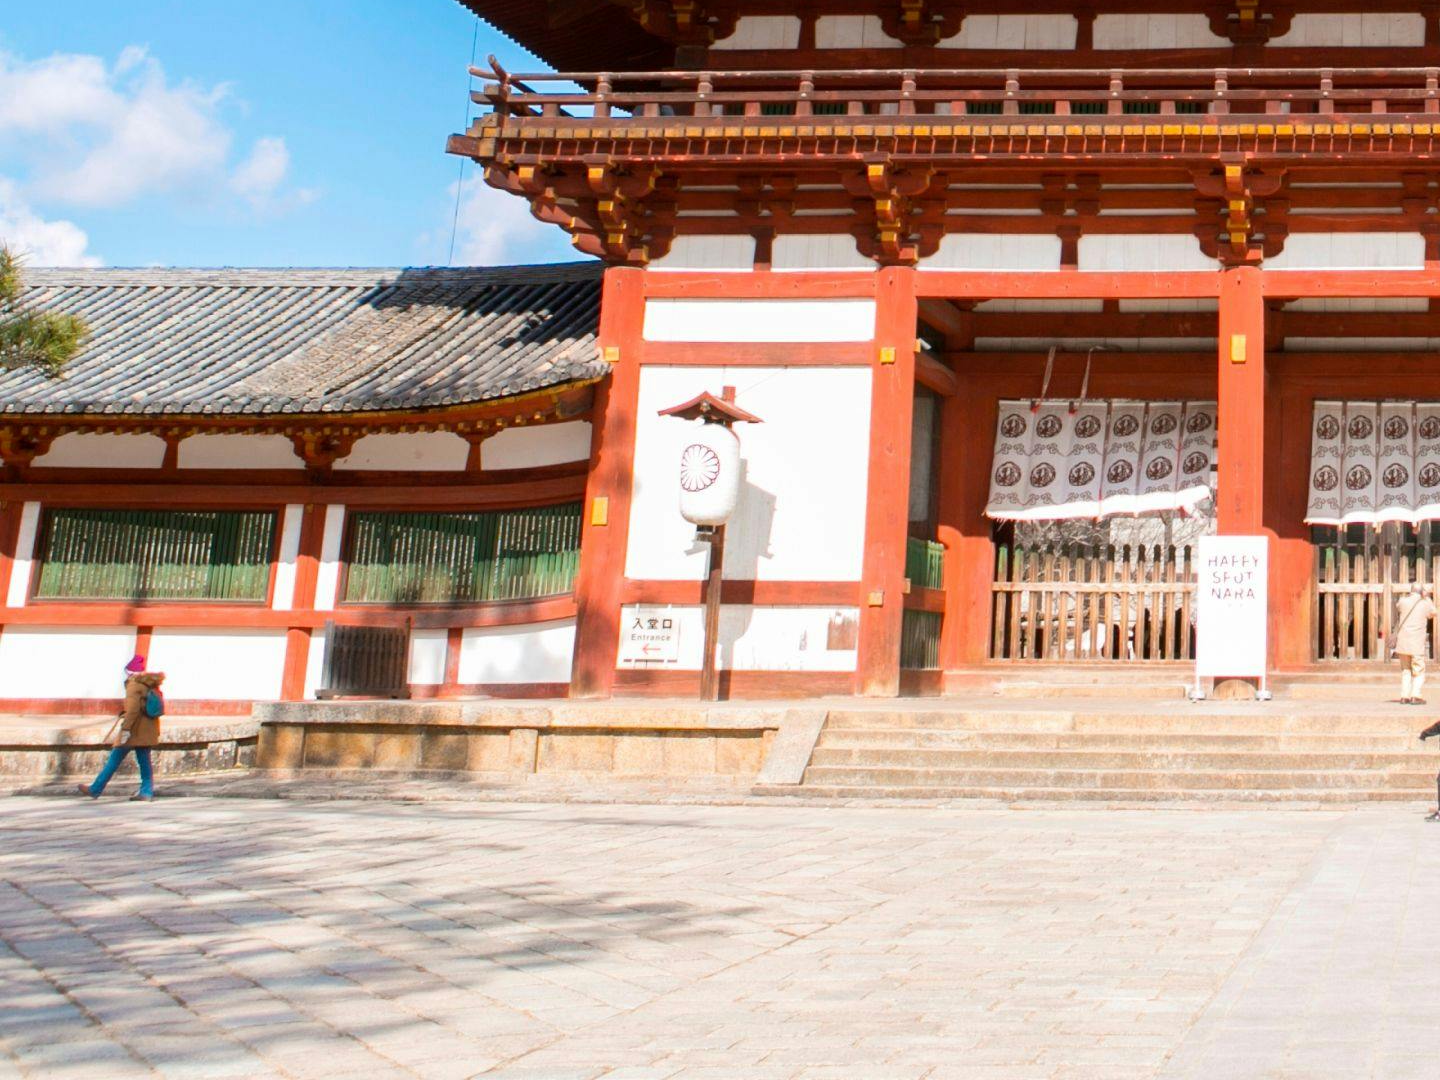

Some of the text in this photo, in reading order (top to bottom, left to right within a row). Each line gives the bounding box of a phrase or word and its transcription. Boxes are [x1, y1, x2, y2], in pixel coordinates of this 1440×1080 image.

[1211, 588, 1255, 599] NARA
[632, 617, 672, 630] 入堂口
[631, 633, 671, 641] Entrance
